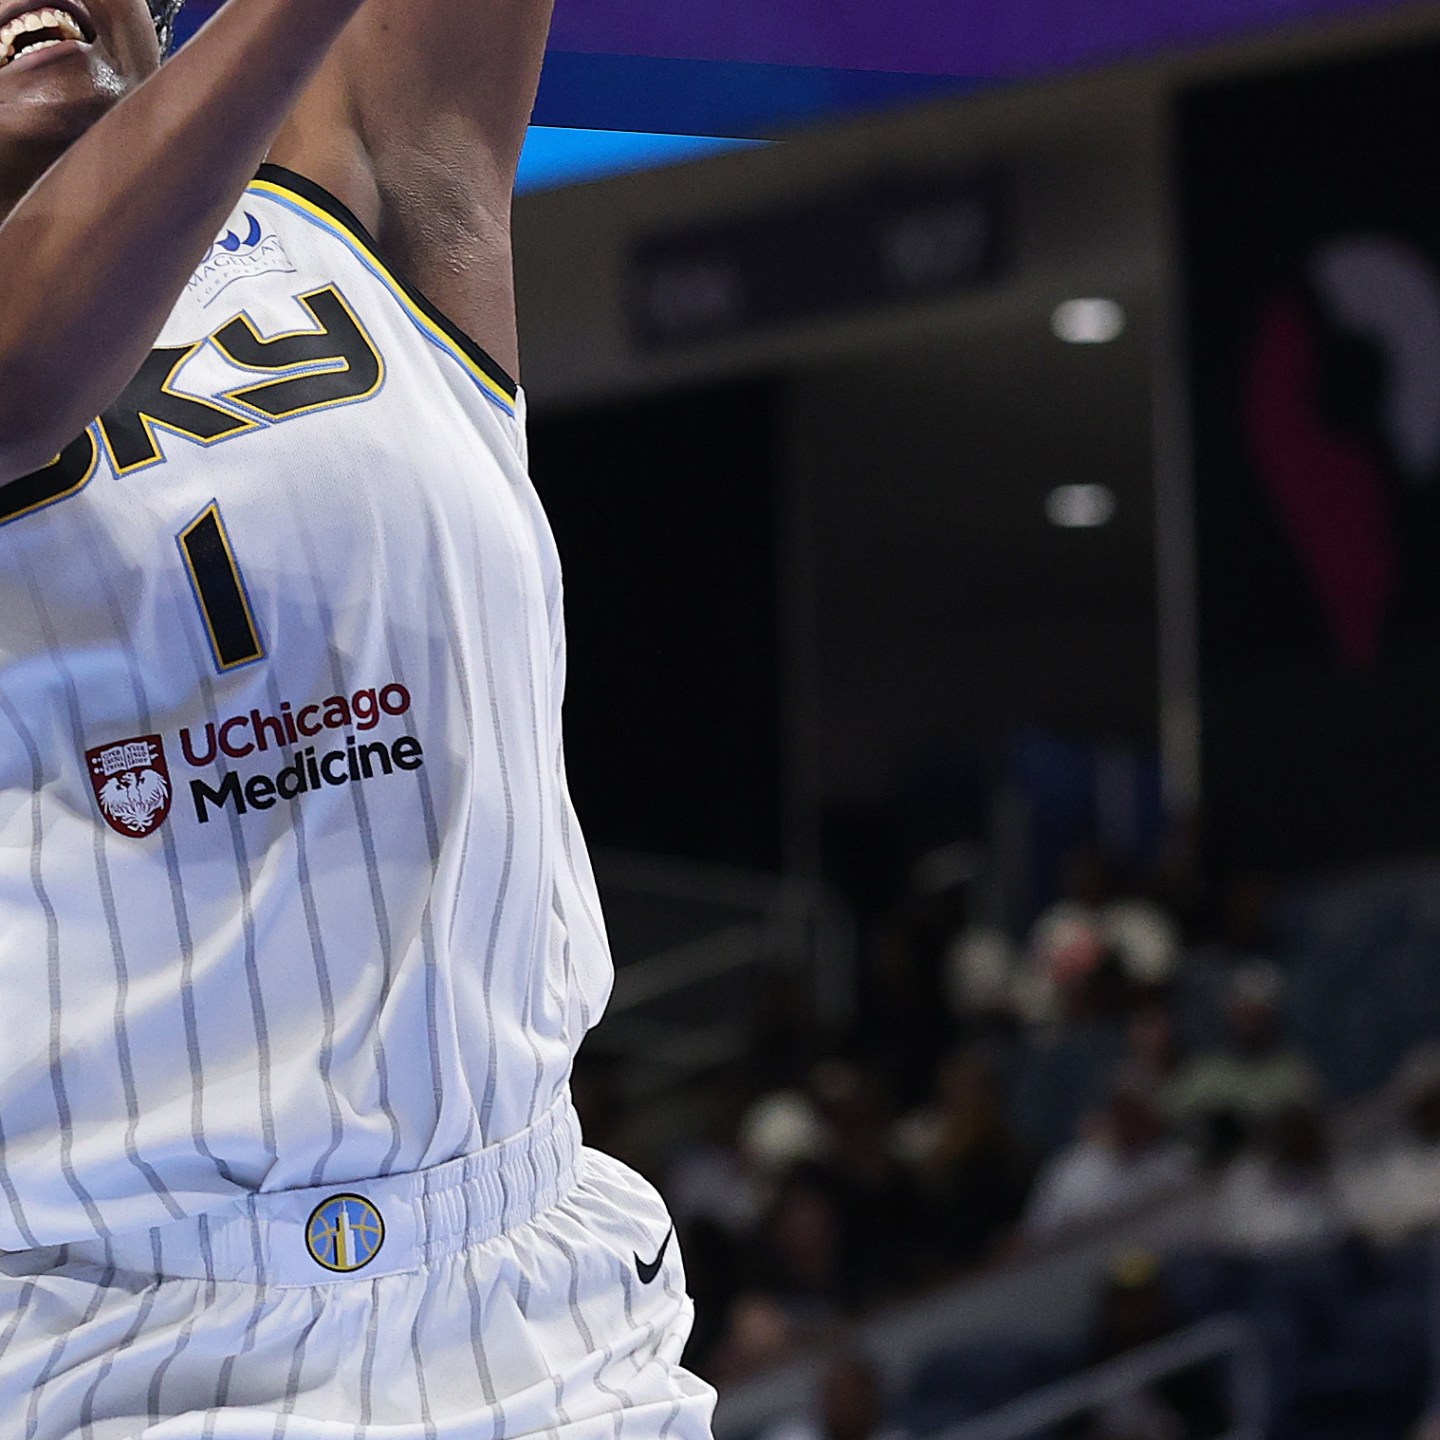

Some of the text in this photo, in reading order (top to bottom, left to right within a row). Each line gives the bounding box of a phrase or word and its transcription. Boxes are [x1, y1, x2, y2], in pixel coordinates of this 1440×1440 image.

[175, 498, 264, 673] 1
[179, 683, 410, 767] UChicago
[189, 735, 423, 824] Medicine
